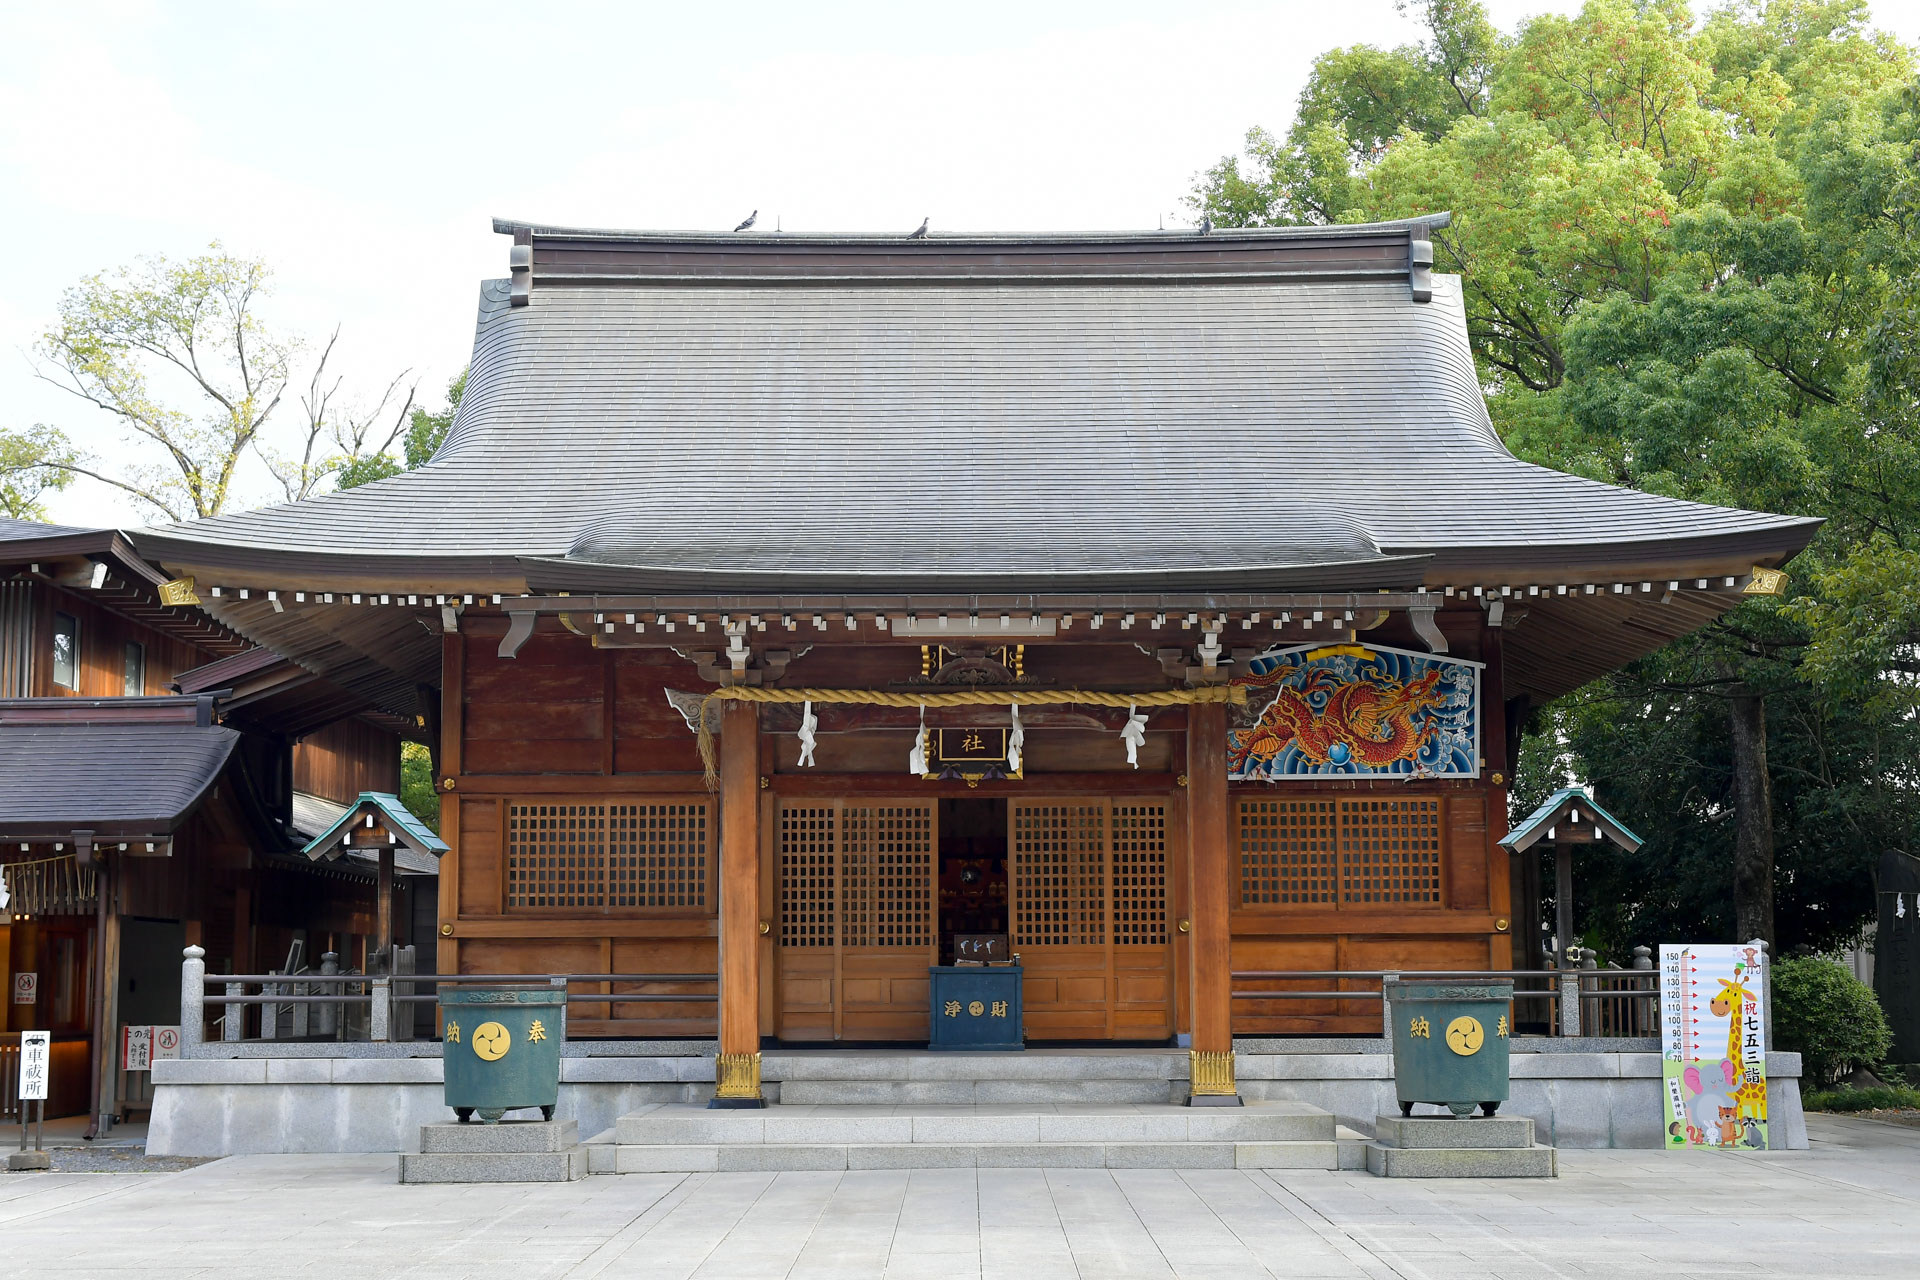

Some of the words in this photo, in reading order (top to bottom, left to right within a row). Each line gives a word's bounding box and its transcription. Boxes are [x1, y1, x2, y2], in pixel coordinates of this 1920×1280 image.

[961, 728, 986, 752] 社
[1667, 978, 1680, 986] 130
[1667, 991, 1680, 999] 120
[944, 1000, 962, 1018] 浄
[990, 1000, 1009, 1018] 財
[1668, 1003, 1680, 1011] 110
[1668, 1016, 1681, 1024] 100
[446, 1020, 461, 1044] 納
[528, 1019, 547, 1045] 奉
[1410, 1015, 1431, 1040] 納
[1496, 1014, 1509, 1040] 奉
[1672, 1029, 1681, 1037] 90
[1672, 1042, 1682, 1050] 80
[1673, 1055, 1682, 1063] 70
[26, 1047, 43, 1096] 車祓所
